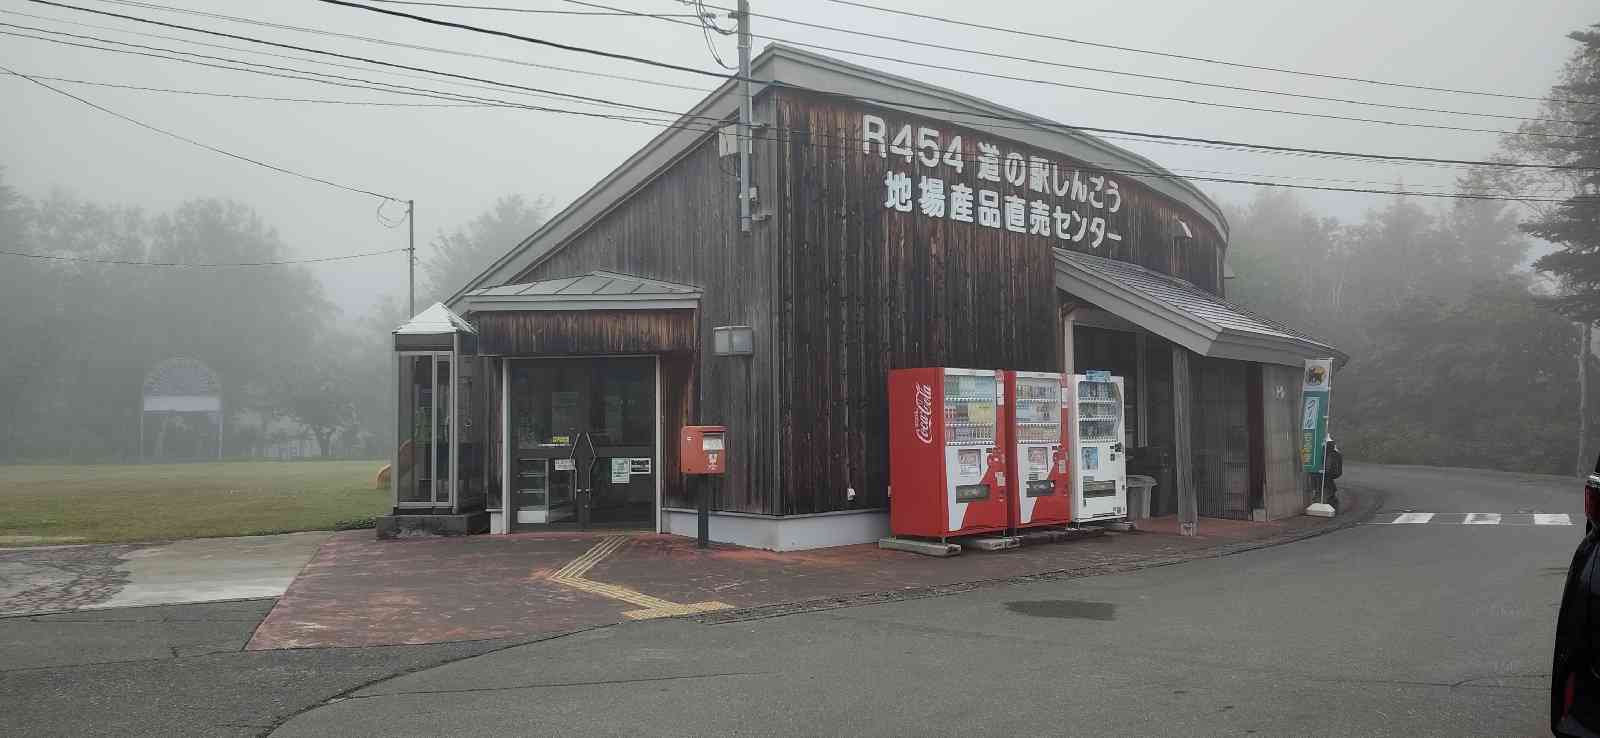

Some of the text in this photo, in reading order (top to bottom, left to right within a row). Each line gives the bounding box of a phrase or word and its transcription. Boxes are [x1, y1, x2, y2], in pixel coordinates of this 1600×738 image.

[863, 114, 1122, 213] R454 道の駅しんごう
[884, 171, 1122, 249] 地場産品直売センター
[915, 383, 933, 444] Coca-Cola
